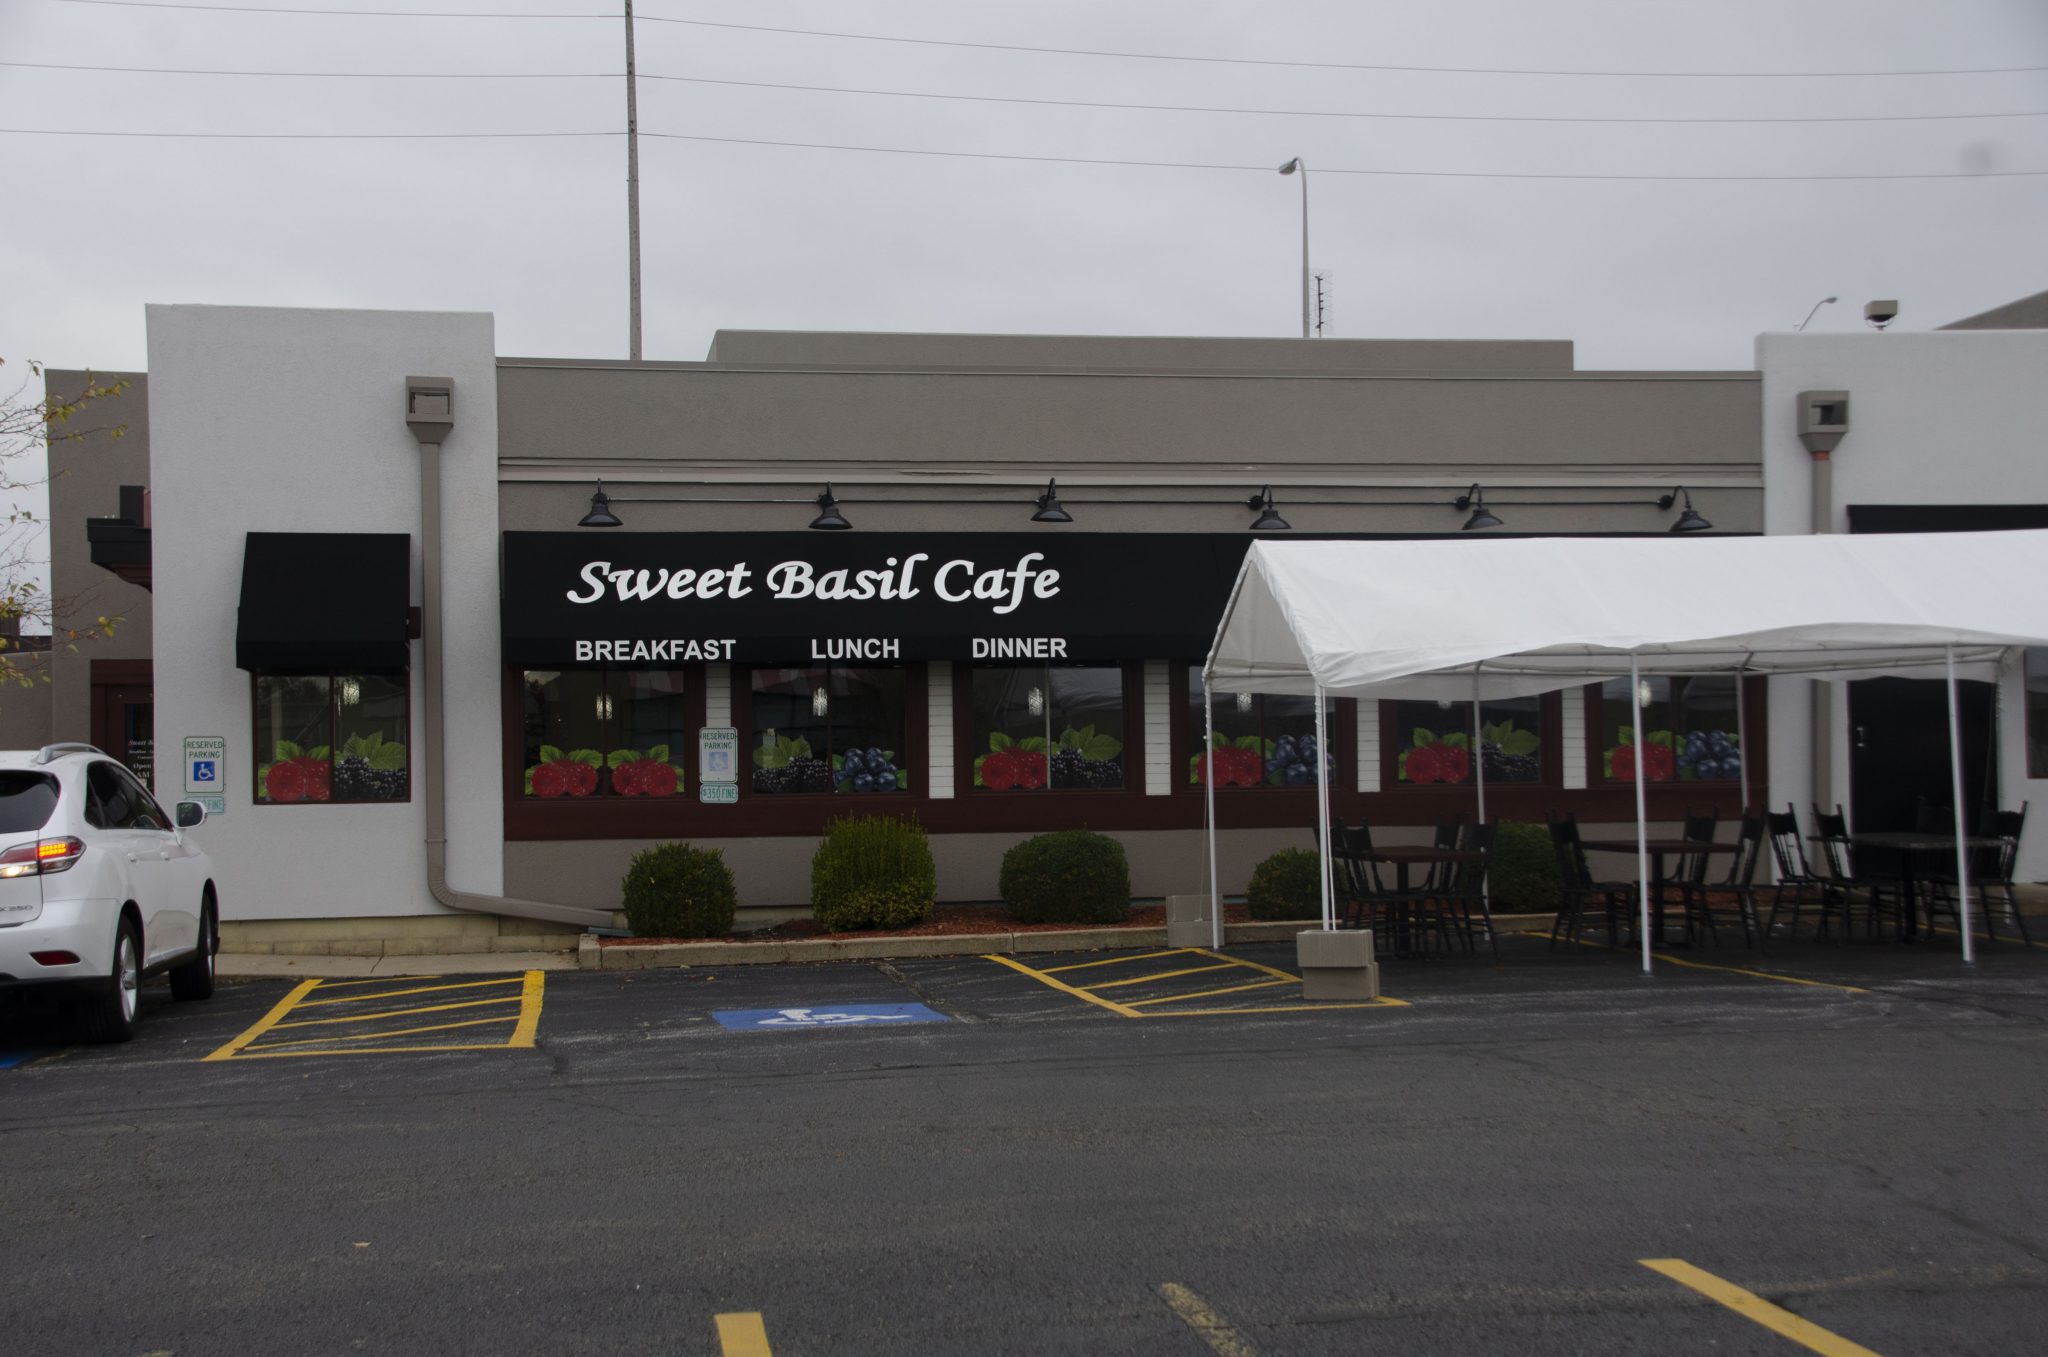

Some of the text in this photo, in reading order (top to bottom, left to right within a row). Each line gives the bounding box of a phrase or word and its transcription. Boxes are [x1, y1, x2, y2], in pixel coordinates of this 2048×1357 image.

[566, 552, 1061, 615] Sweet Basil Cafe
[575, 640, 737, 661] BREAKFAST
[811, 638, 899, 659] LUNCH
[972, 637, 1068, 658] DINNER
[702, 732, 735, 741] RESERVED
[187, 741, 223, 749] RESERVED
[704, 742, 733, 750] PARKING
[188, 751, 220, 759] PARKING
[703, 788, 736, 799] $350 FINE
